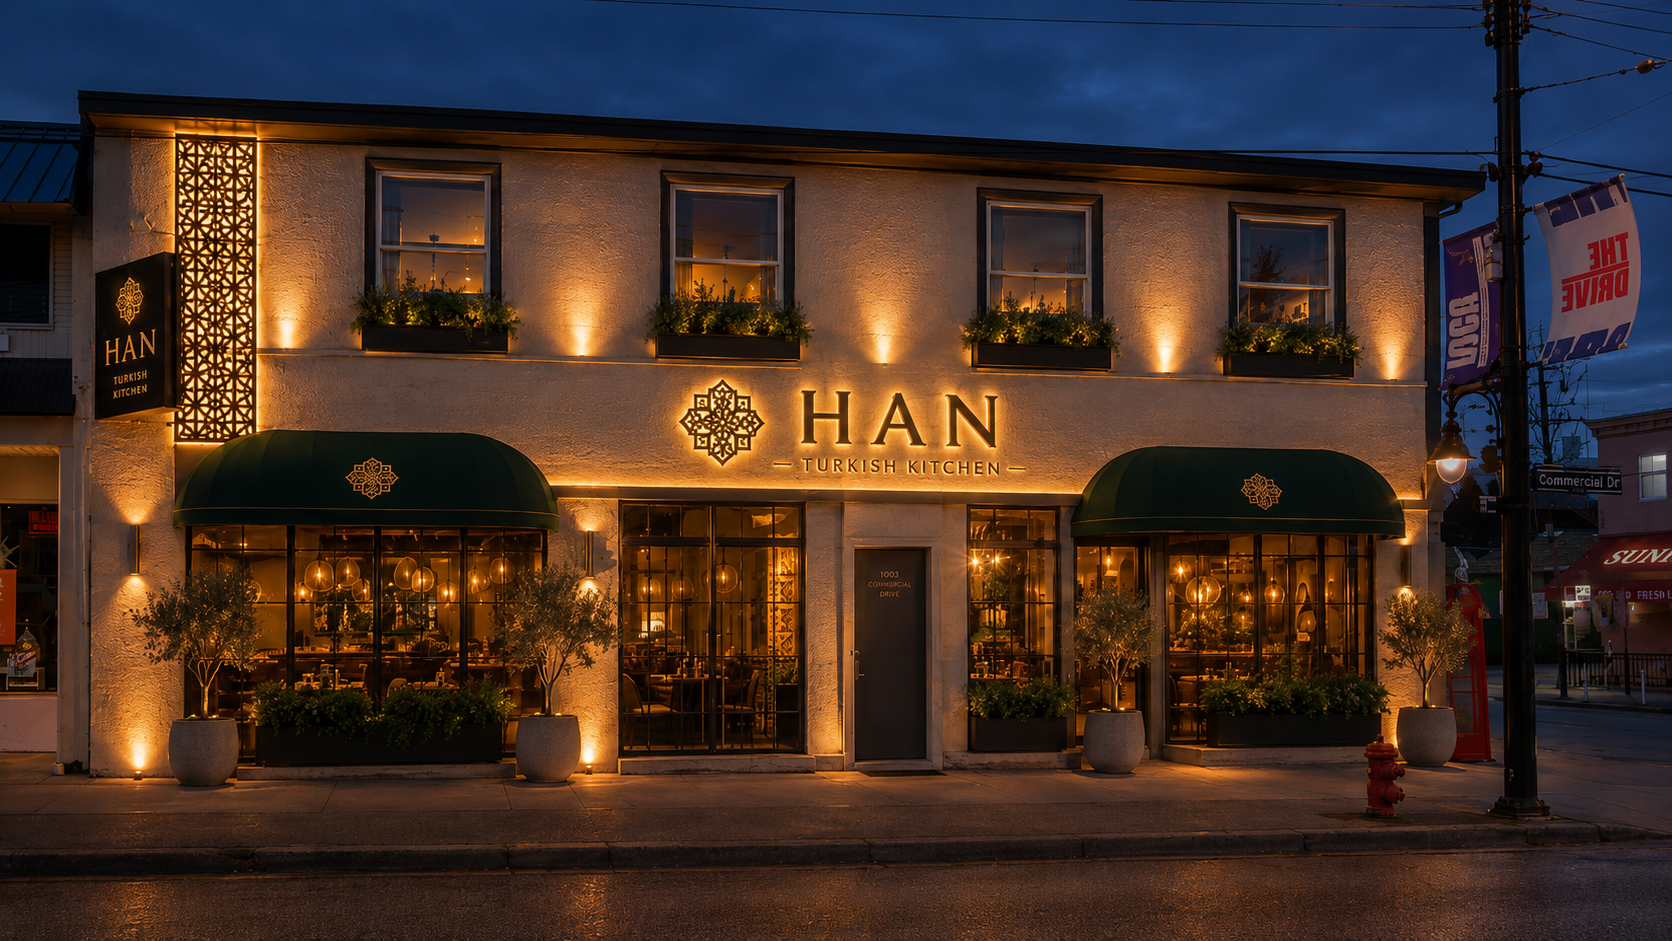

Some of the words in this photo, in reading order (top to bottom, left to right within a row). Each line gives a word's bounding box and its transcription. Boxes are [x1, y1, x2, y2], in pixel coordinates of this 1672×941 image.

[105, 329, 156, 366] HAN
[113, 370, 147, 386] TURKISH
[113, 384, 147, 399] KITCHEN
[801, 390, 998, 448] HAN
[802, 458, 896, 473] TURKISH
[908, 460, 1000, 476] KITCHEN
[1539, 474, 1603, 488] Commercial
[1607, 476, 1620, 488] Dr
